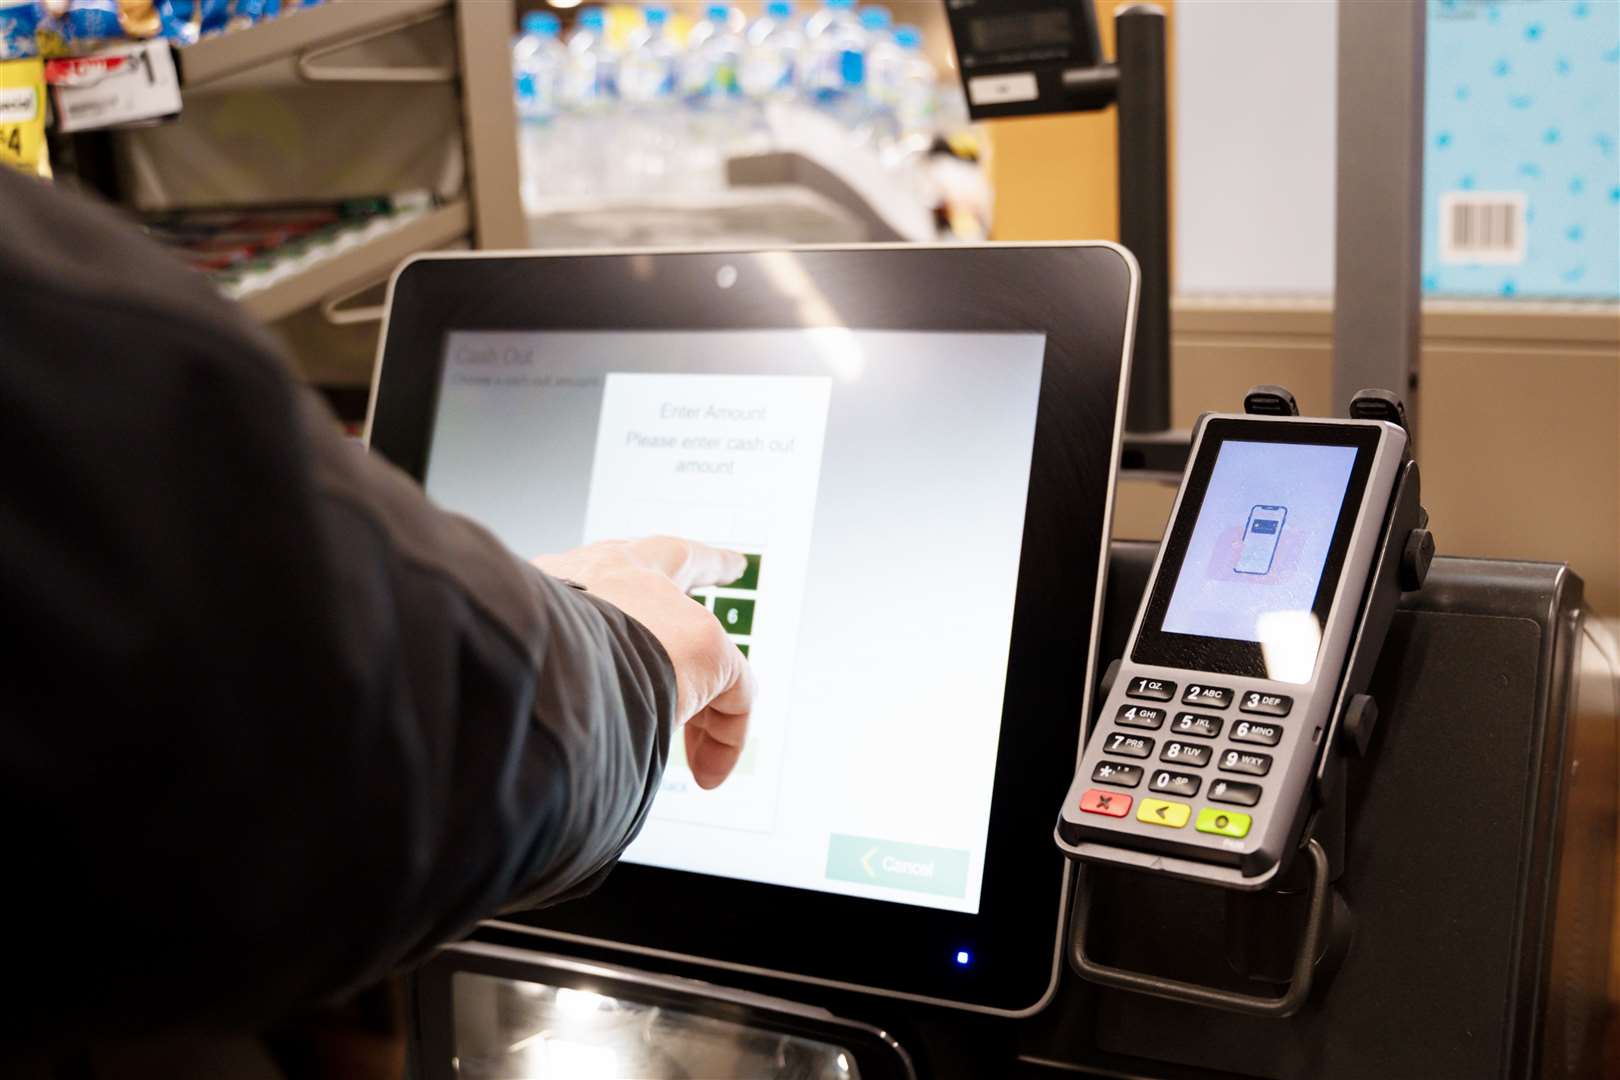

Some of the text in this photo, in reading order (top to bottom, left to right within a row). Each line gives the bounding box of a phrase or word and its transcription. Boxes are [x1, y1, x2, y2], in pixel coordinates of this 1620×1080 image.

[659, 402, 768, 424] Enter Amount
[626, 432, 796, 454] Please enter cash out
[674, 460, 735, 476] amount
[727, 608, 739, 625] 6
[1139, 680, 1147, 693] 1
[1188, 686, 1223, 700] 2 ABC
[1247, 693, 1281, 708] 3 DEF
[1124, 707, 1157, 721] 4 GHI
[1180, 715, 1210, 729] 5 JKL
[1236, 722, 1274, 737] 6 MNO
[1112, 735, 1144, 749] 7 PRS
[1168, 744, 1181, 758] 8
[1225, 751, 1264, 766] 9 WXY
[1157, 773, 1170, 787] 0
[881, 854, 935, 880] Cancel
